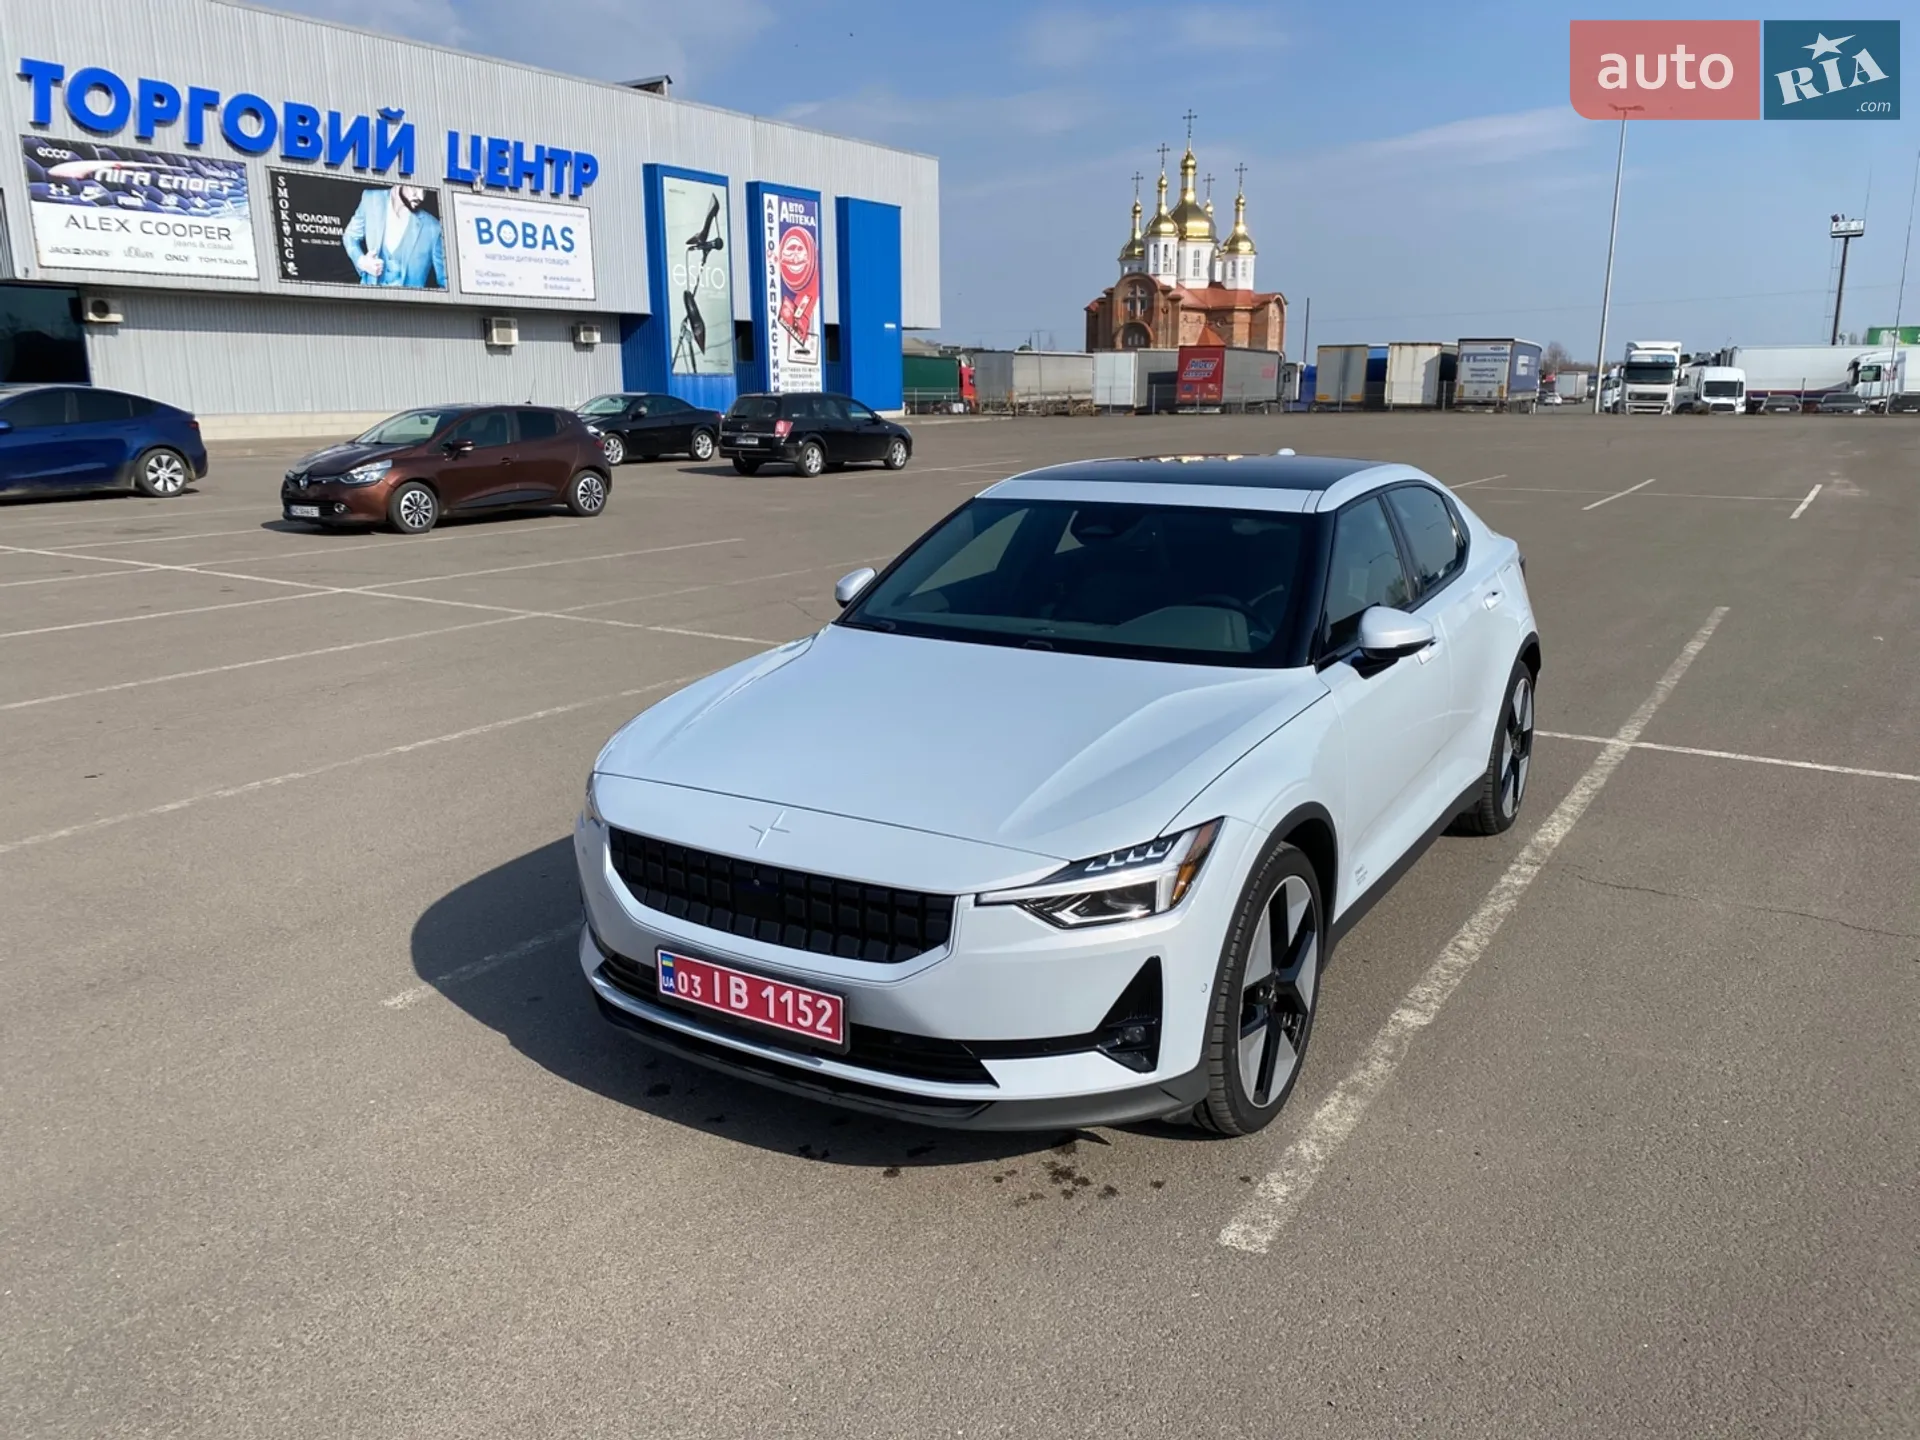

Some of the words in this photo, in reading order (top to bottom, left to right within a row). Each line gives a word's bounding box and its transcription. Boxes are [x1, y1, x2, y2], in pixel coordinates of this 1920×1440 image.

[19, 56, 415, 175] ТОРГОВИЙ
[447, 130, 599, 197] ЦЕНТР
[64, 213, 132, 233] ALEX
[140, 220, 232, 241] COOPER
[295, 223, 344, 236] КОСТЮМИ
[296, 212, 341, 226] ЧОЛОВІЧІ
[474, 217, 575, 253] BOBAS
[164, 253, 190, 262] ONLY
[662, 975, 675, 989] UA
[677, 971, 702, 999] 03
[760, 985, 833, 1035] 1152
